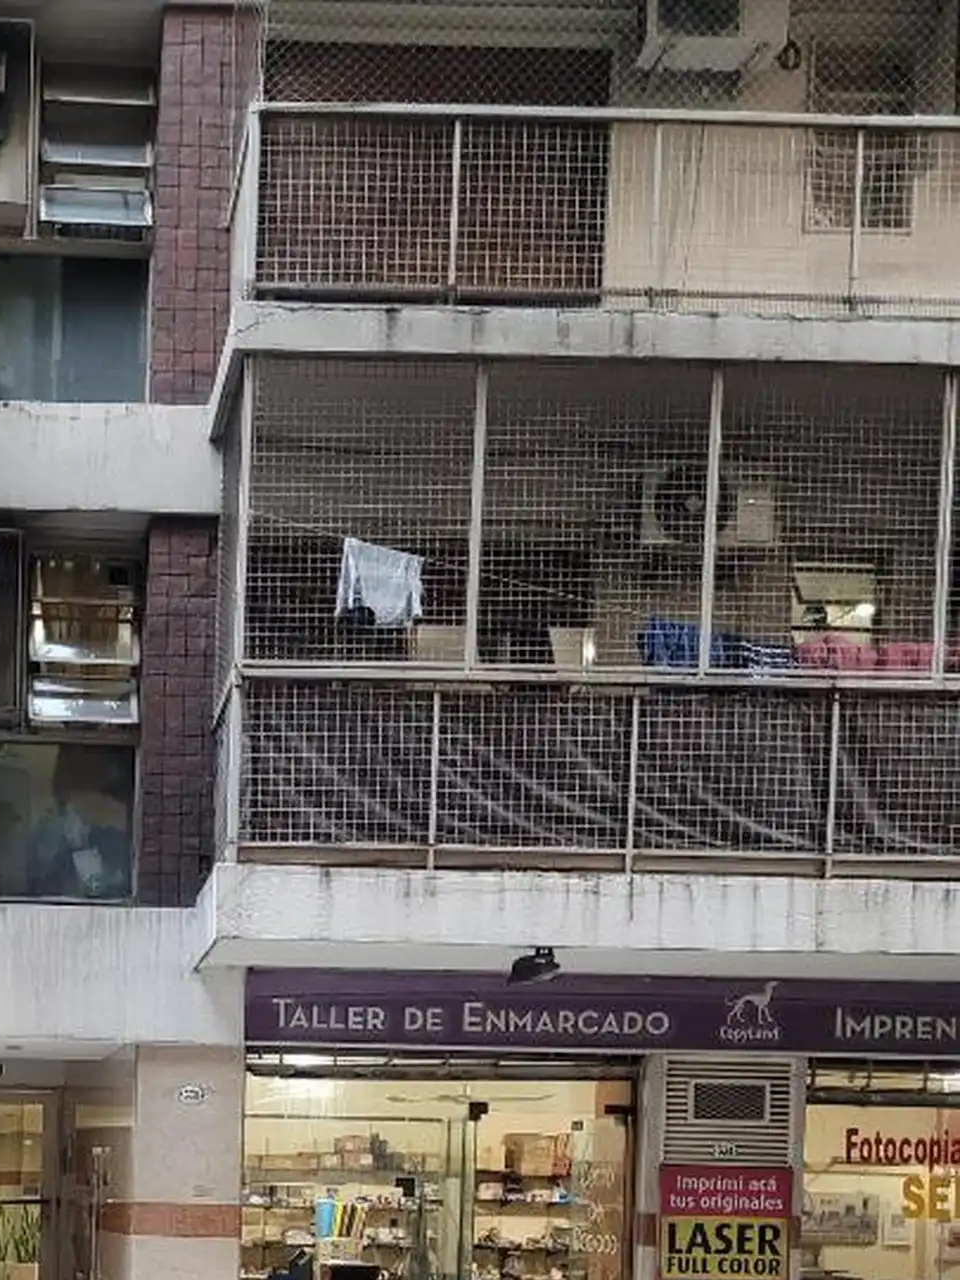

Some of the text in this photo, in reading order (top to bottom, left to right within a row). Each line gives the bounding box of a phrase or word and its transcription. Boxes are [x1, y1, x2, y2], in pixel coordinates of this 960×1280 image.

[403, 1006, 445, 1032] DE
[669, 1193, 784, 1214] tus originales
[666, 1222, 782, 1256] LASER
[666, 1255, 781, 1275] FULL COLOR
